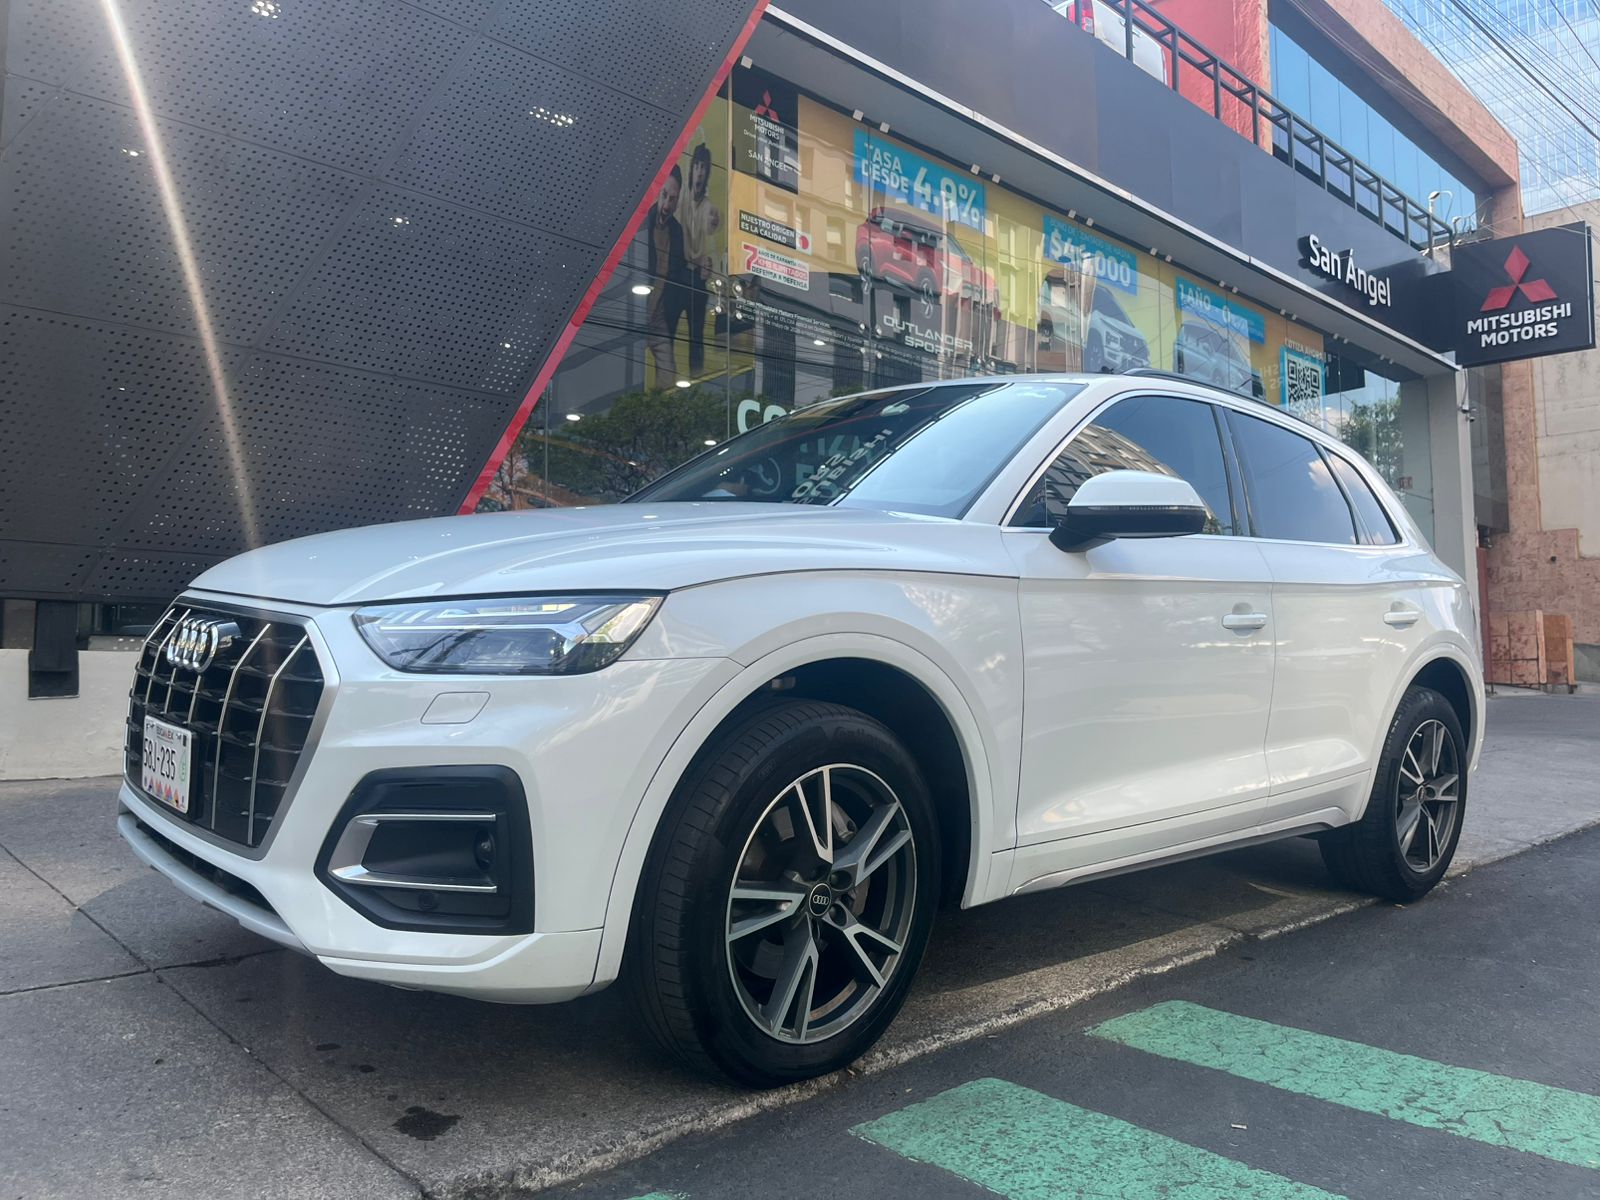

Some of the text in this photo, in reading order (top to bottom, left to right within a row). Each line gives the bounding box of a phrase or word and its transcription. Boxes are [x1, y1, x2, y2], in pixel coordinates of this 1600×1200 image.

[750, 114, 785, 134] MITSUBISHI
[755, 124, 780, 140] MOTORS
[748, 150, 763, 162] SAN
[863, 142, 903, 174] TASA
[861, 158, 910, 194] DESDE
[913, 166, 980, 223] 4.9%
[741, 212, 795, 238] NUESTRO ORIGEN
[741, 221, 787, 244] ES LA CALIDAD
[743, 244, 757, 270] 7
[1309, 234, 1391, 307] San Ángel
[1467, 302, 1572, 335] MITSUBISHI
[883, 314, 974, 352] OUTLANDER
[1481, 322, 1558, 347] MOTORS
[904, 335, 954, 358] SPORT
